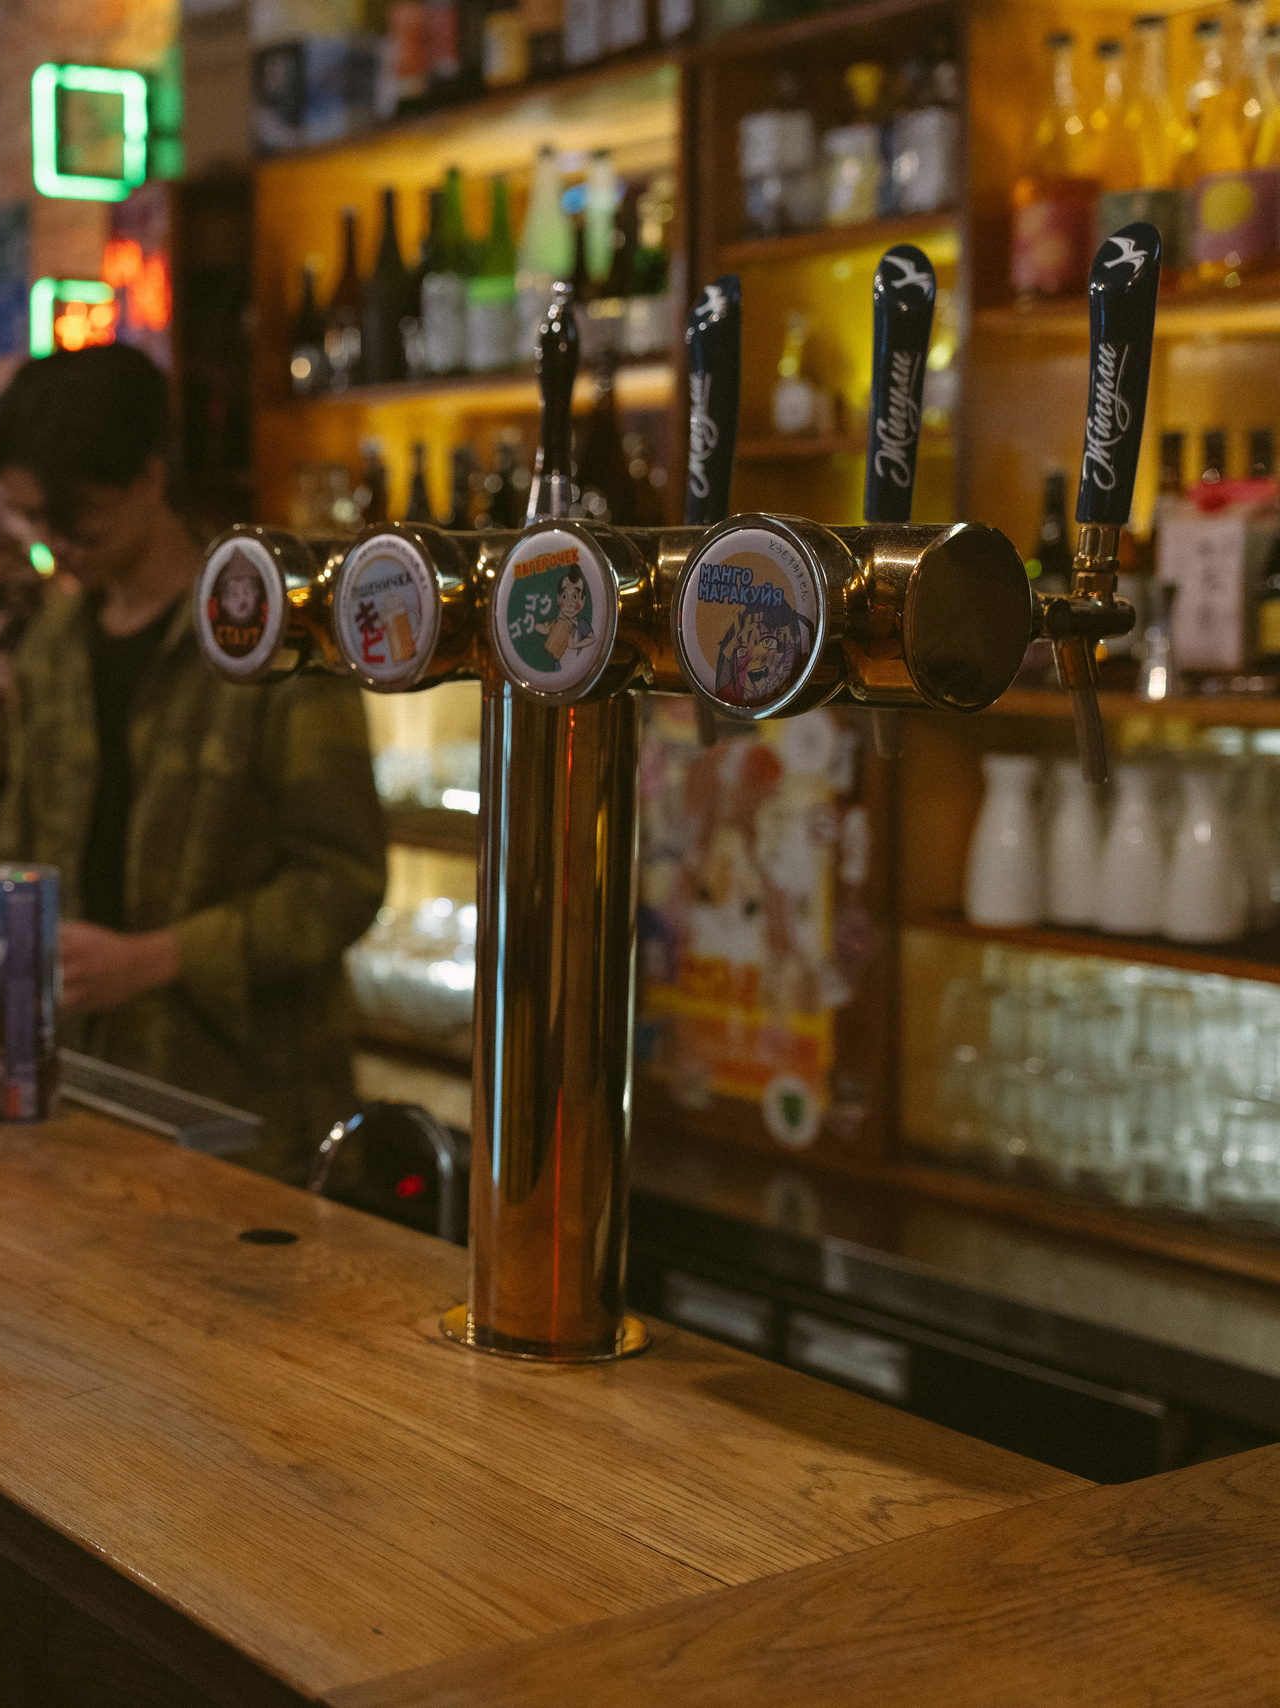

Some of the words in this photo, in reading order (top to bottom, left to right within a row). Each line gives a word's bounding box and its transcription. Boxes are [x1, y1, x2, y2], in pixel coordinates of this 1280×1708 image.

[875, 352, 922, 487] Жигули
[1083, 342, 1131, 491] Жигули
[697, 582, 785, 607] МАРАКУЙЯ
[699, 563, 754, 585] МАНГО
